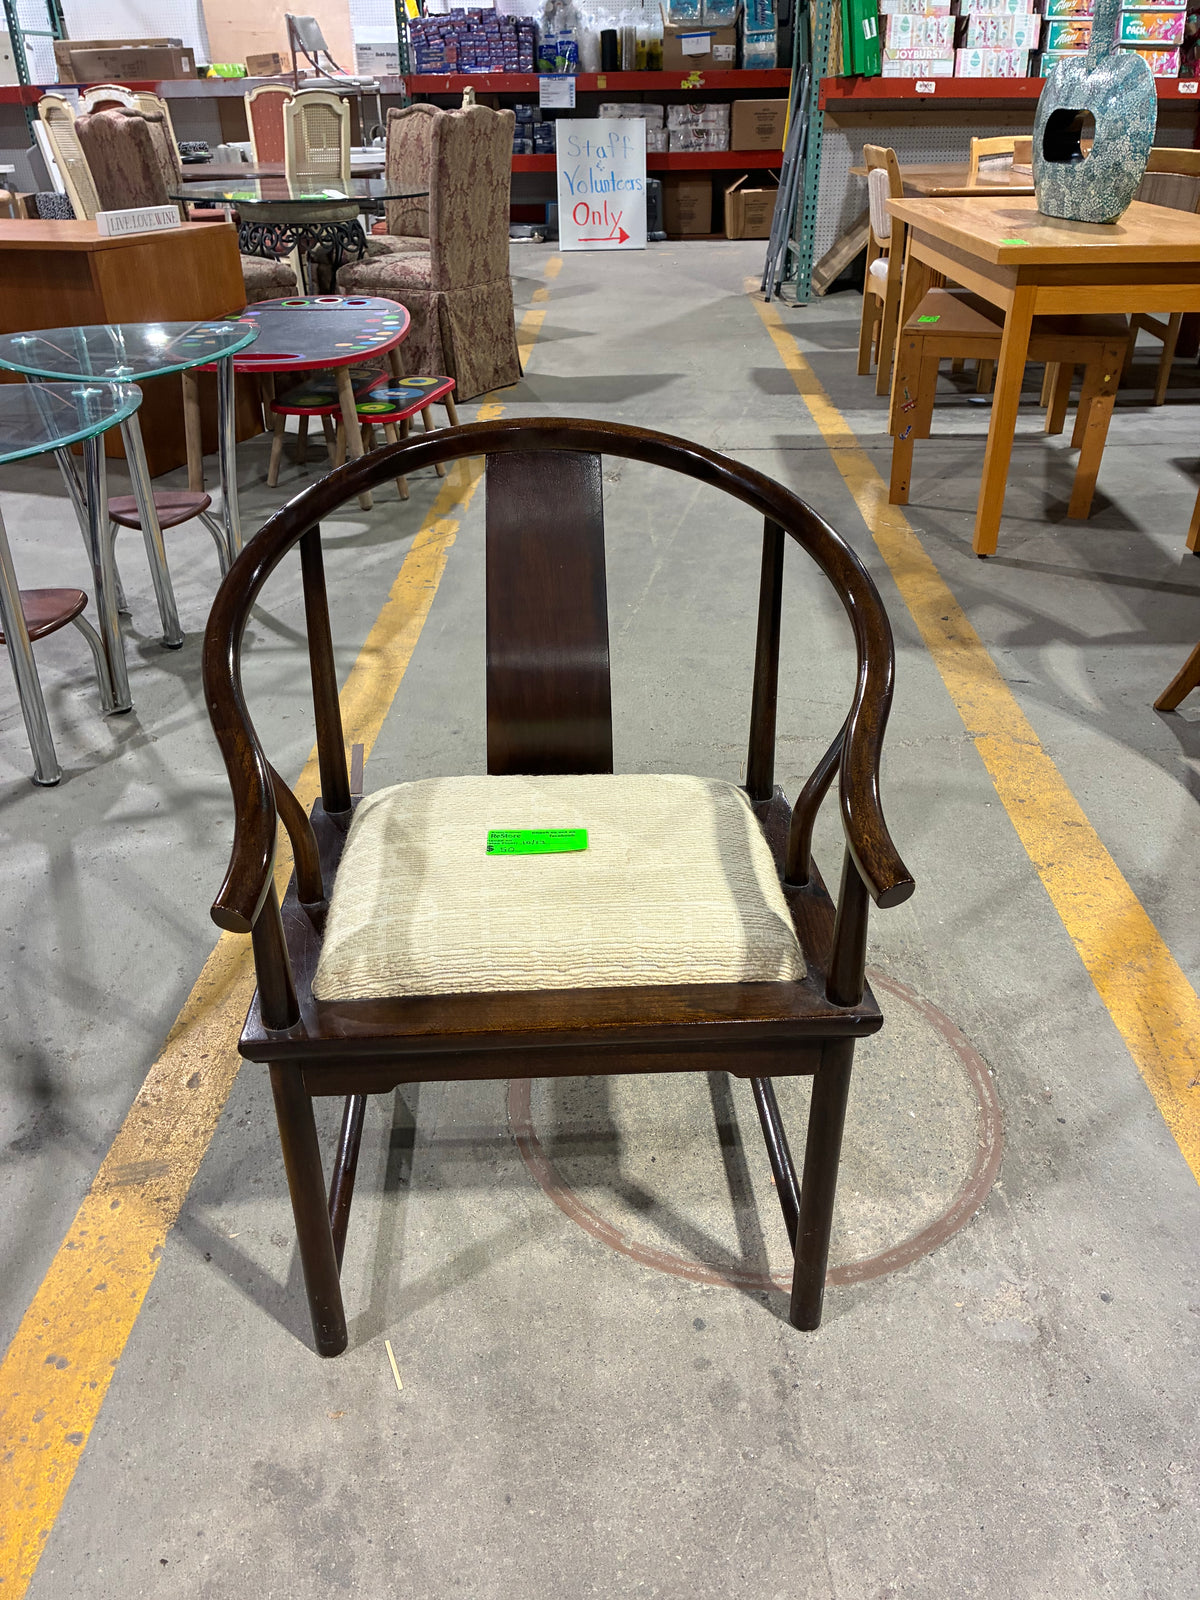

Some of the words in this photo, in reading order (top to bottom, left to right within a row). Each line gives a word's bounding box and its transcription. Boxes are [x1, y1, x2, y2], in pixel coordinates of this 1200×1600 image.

[1126, 25, 1146, 35] PACK
[895, 49, 944, 59] JOYBURST
[567, 132, 635, 159] Staff
[563, 165, 643, 196] Volunteers
[572, 200, 624, 238] Only
